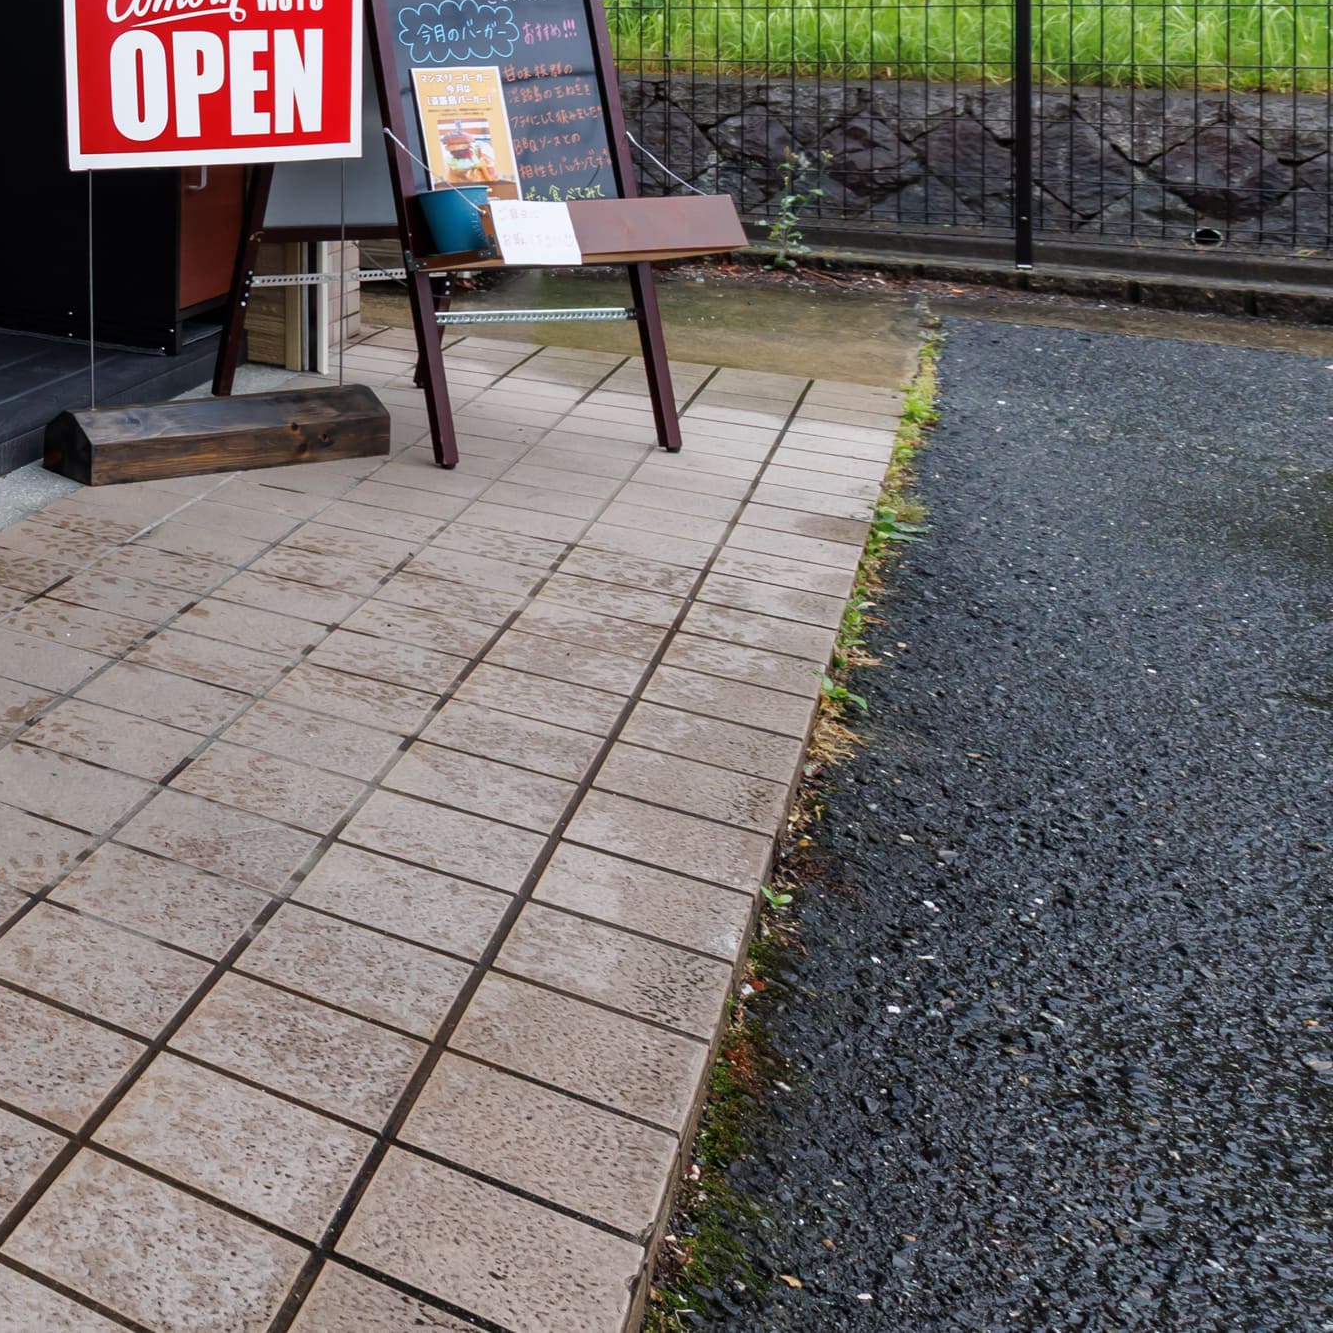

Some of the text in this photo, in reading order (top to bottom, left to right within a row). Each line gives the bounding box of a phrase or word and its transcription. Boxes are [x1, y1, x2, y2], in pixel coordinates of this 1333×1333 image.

[416, 18, 508, 46] 今月のバーガー
[109, 28, 324, 142] OPEN
